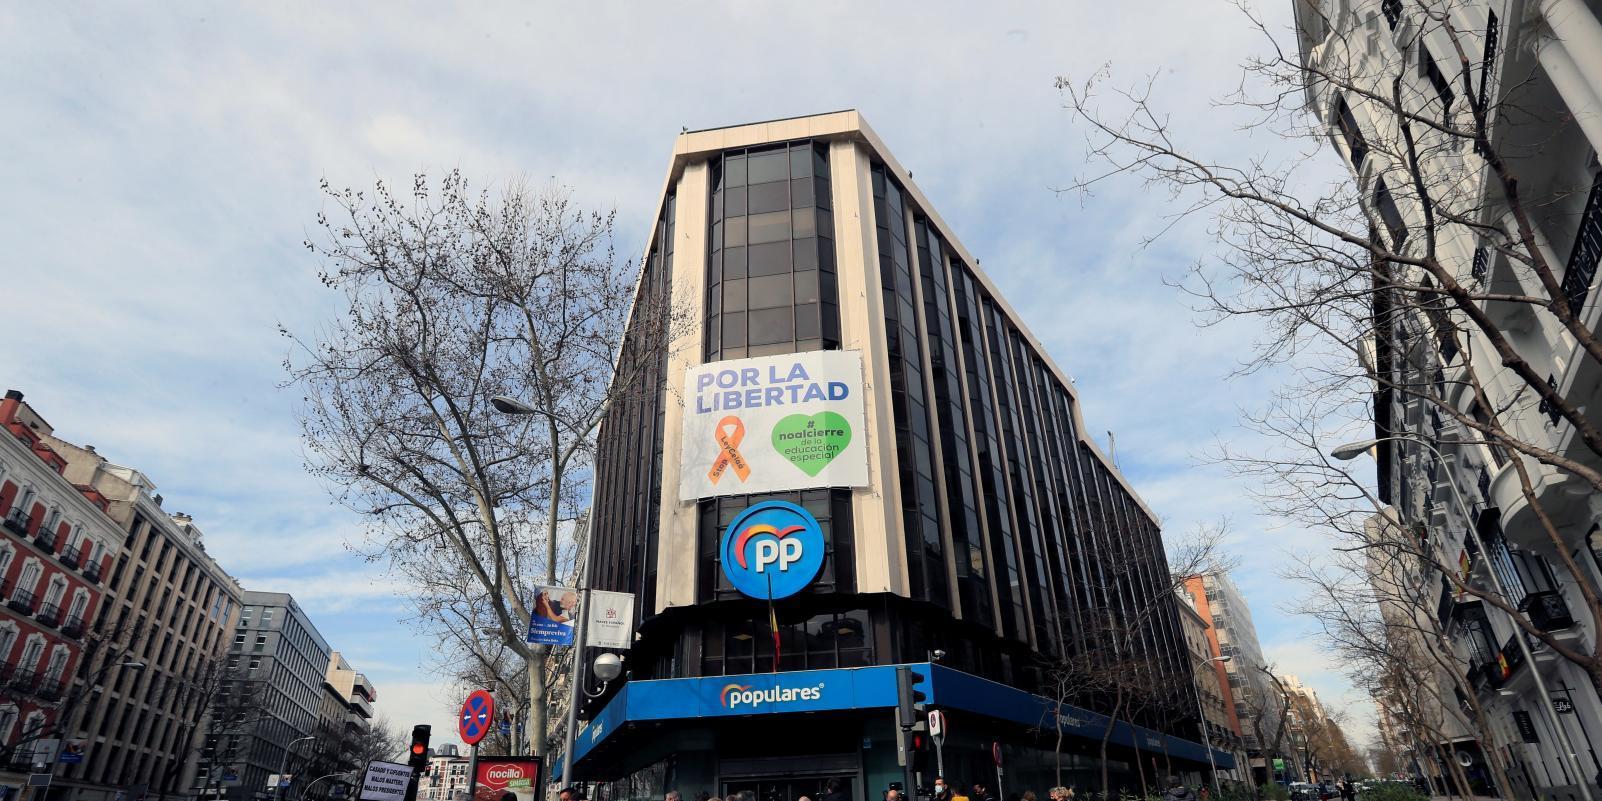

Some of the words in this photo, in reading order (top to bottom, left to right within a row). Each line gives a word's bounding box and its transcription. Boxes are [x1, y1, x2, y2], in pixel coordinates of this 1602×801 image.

[697, 367, 760, 393] POR
[769, 363, 810, 384] LA
[696, 381, 849, 414] LIBERTAD
[779, 428, 844, 441] noalcierre
[814, 438, 822, 446] la
[784, 443, 839, 456] educación
[790, 451, 834, 463] especial
[712, 458, 728, 478] Stop
[730, 684, 821, 709] populares
[490, 768, 520, 779] nocilla
[364, 784, 378, 792] MALOS
